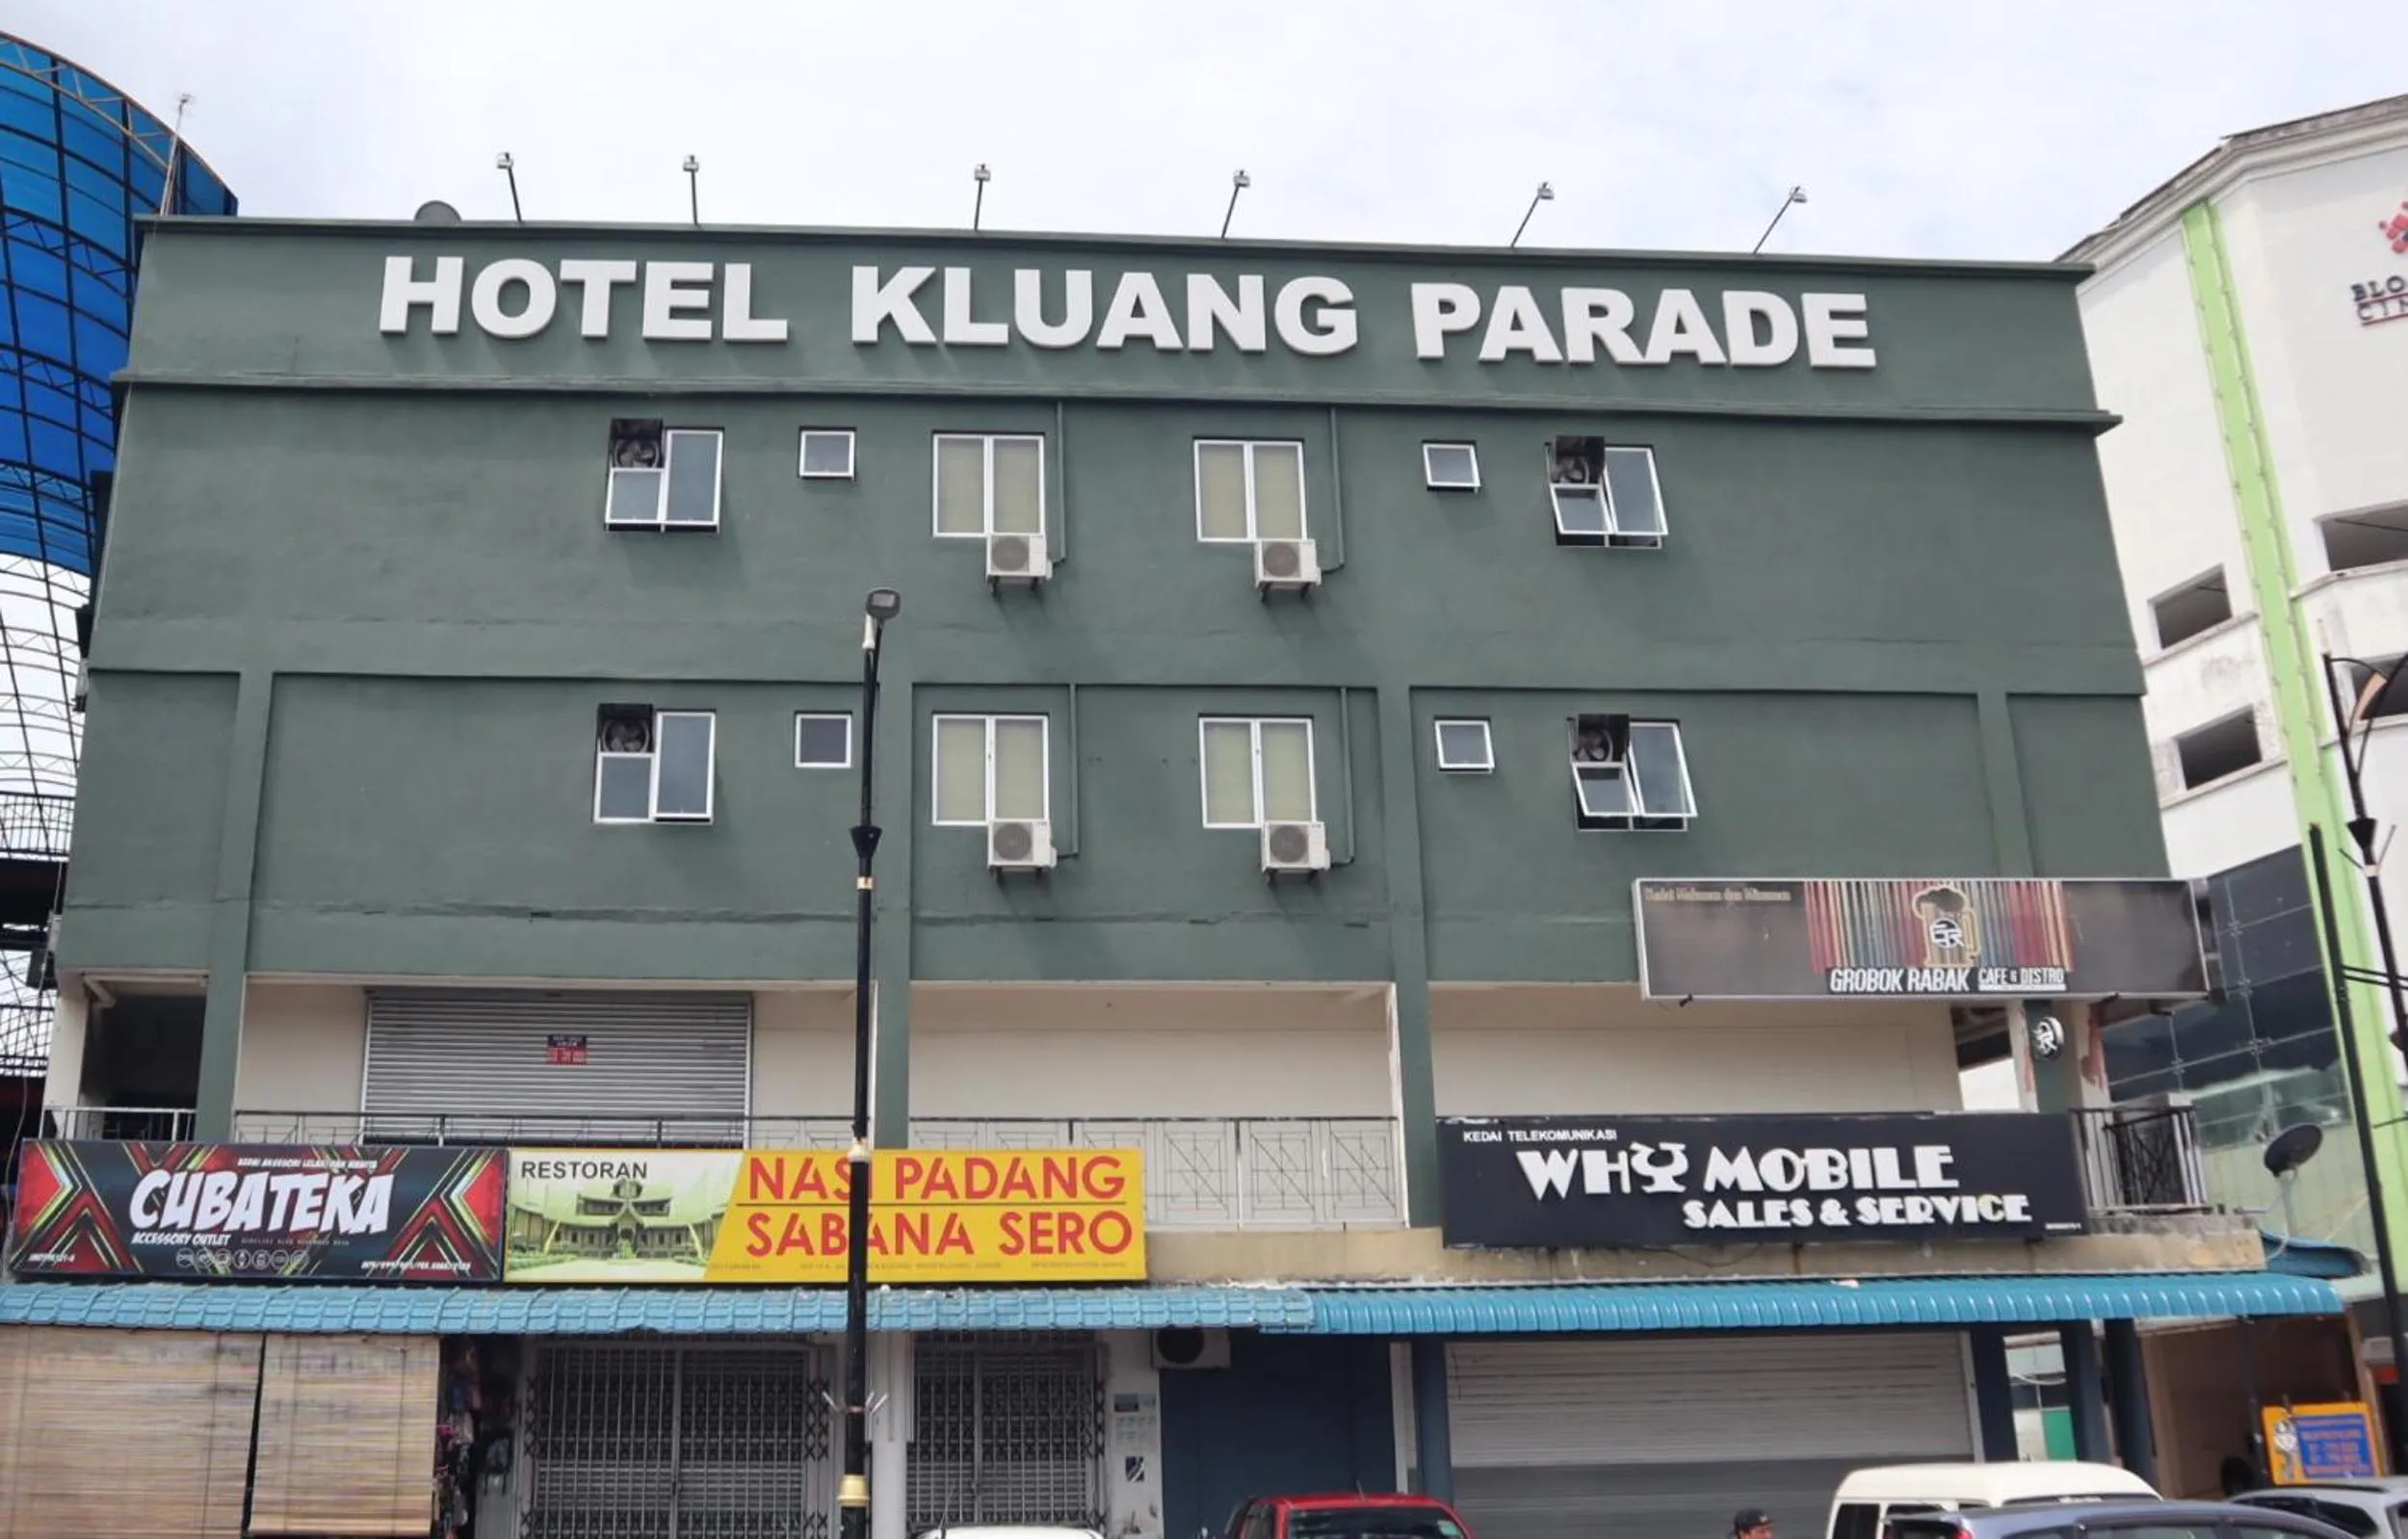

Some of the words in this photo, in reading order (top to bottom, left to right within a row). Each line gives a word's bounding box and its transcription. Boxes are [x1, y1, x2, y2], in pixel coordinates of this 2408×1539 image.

[380, 256, 788, 340] HOTEL
[851, 266, 1358, 356] KLUANG
[1411, 282, 1876, 368] PARADE
[1830, 967, 1903, 993] GROBOK
[1906, 967, 1971, 993] RABAK
[1978, 967, 2007, 984] CAFE
[2020, 967, 2064, 984] DISTRO
[1462, 1130, 1503, 1143] KEDAI
[1507, 1128, 1618, 1142] TELEKOMUNIKASI
[521, 1161, 647, 1181] RESTORAN
[894, 1155, 1126, 1201] PADANG
[1515, 1141, 1689, 1201] WHY
[1703, 1145, 1959, 1192] MOBILE
[129, 1168, 395, 1235] CUBATEKA
[1683, 1198, 1814, 1229] SALES
[1819, 1198, 1851, 1227] &
[1855, 1193, 2032, 1225] SERVICE
[131, 1231, 191, 1245] ACCESSORY
[192, 1233, 232, 1246] OUTLET
[999, 1210, 1134, 1257] SERO
